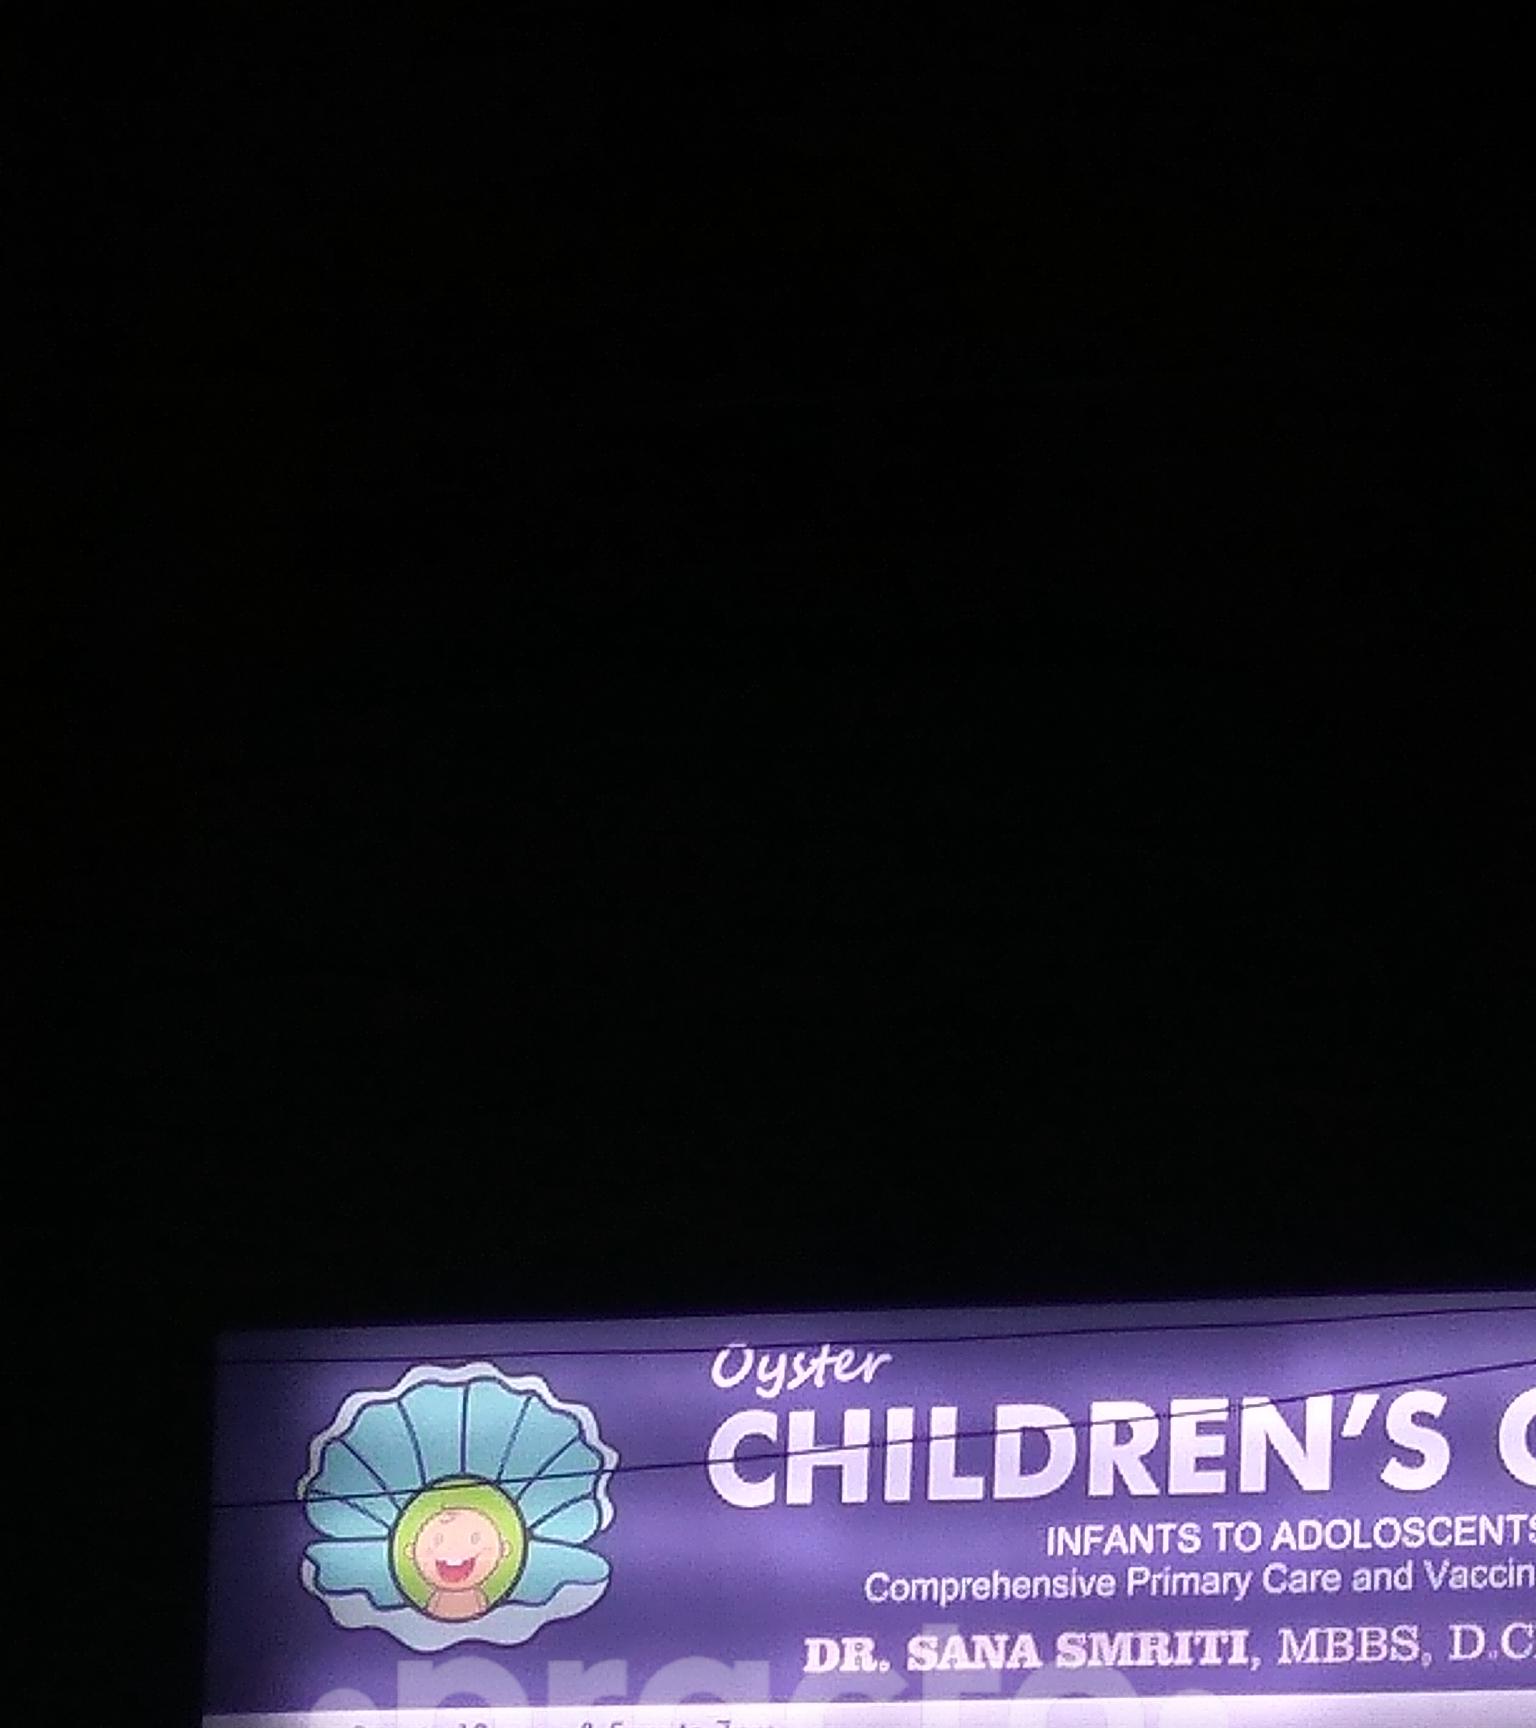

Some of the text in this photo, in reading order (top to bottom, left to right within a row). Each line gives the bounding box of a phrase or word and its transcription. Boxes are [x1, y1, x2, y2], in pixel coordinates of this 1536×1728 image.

[711, 1342, 892, 1398] Oyster
[1047, 1522, 1202, 1556] INFANTS
[1213, 1520, 1262, 1553] TO
[864, 1569, 1116, 1608] Comprehensive
[1128, 1564, 1253, 1602] Primary
[1263, 1562, 1342, 1594] Care
[1352, 1560, 1413, 1592] and
[802, 1636, 892, 1674] DR.
[906, 1634, 1043, 1673] SANA
[1055, 1628, 1262, 1671] SMRITI,
[1276, 1624, 1433, 1667] MBBS,
